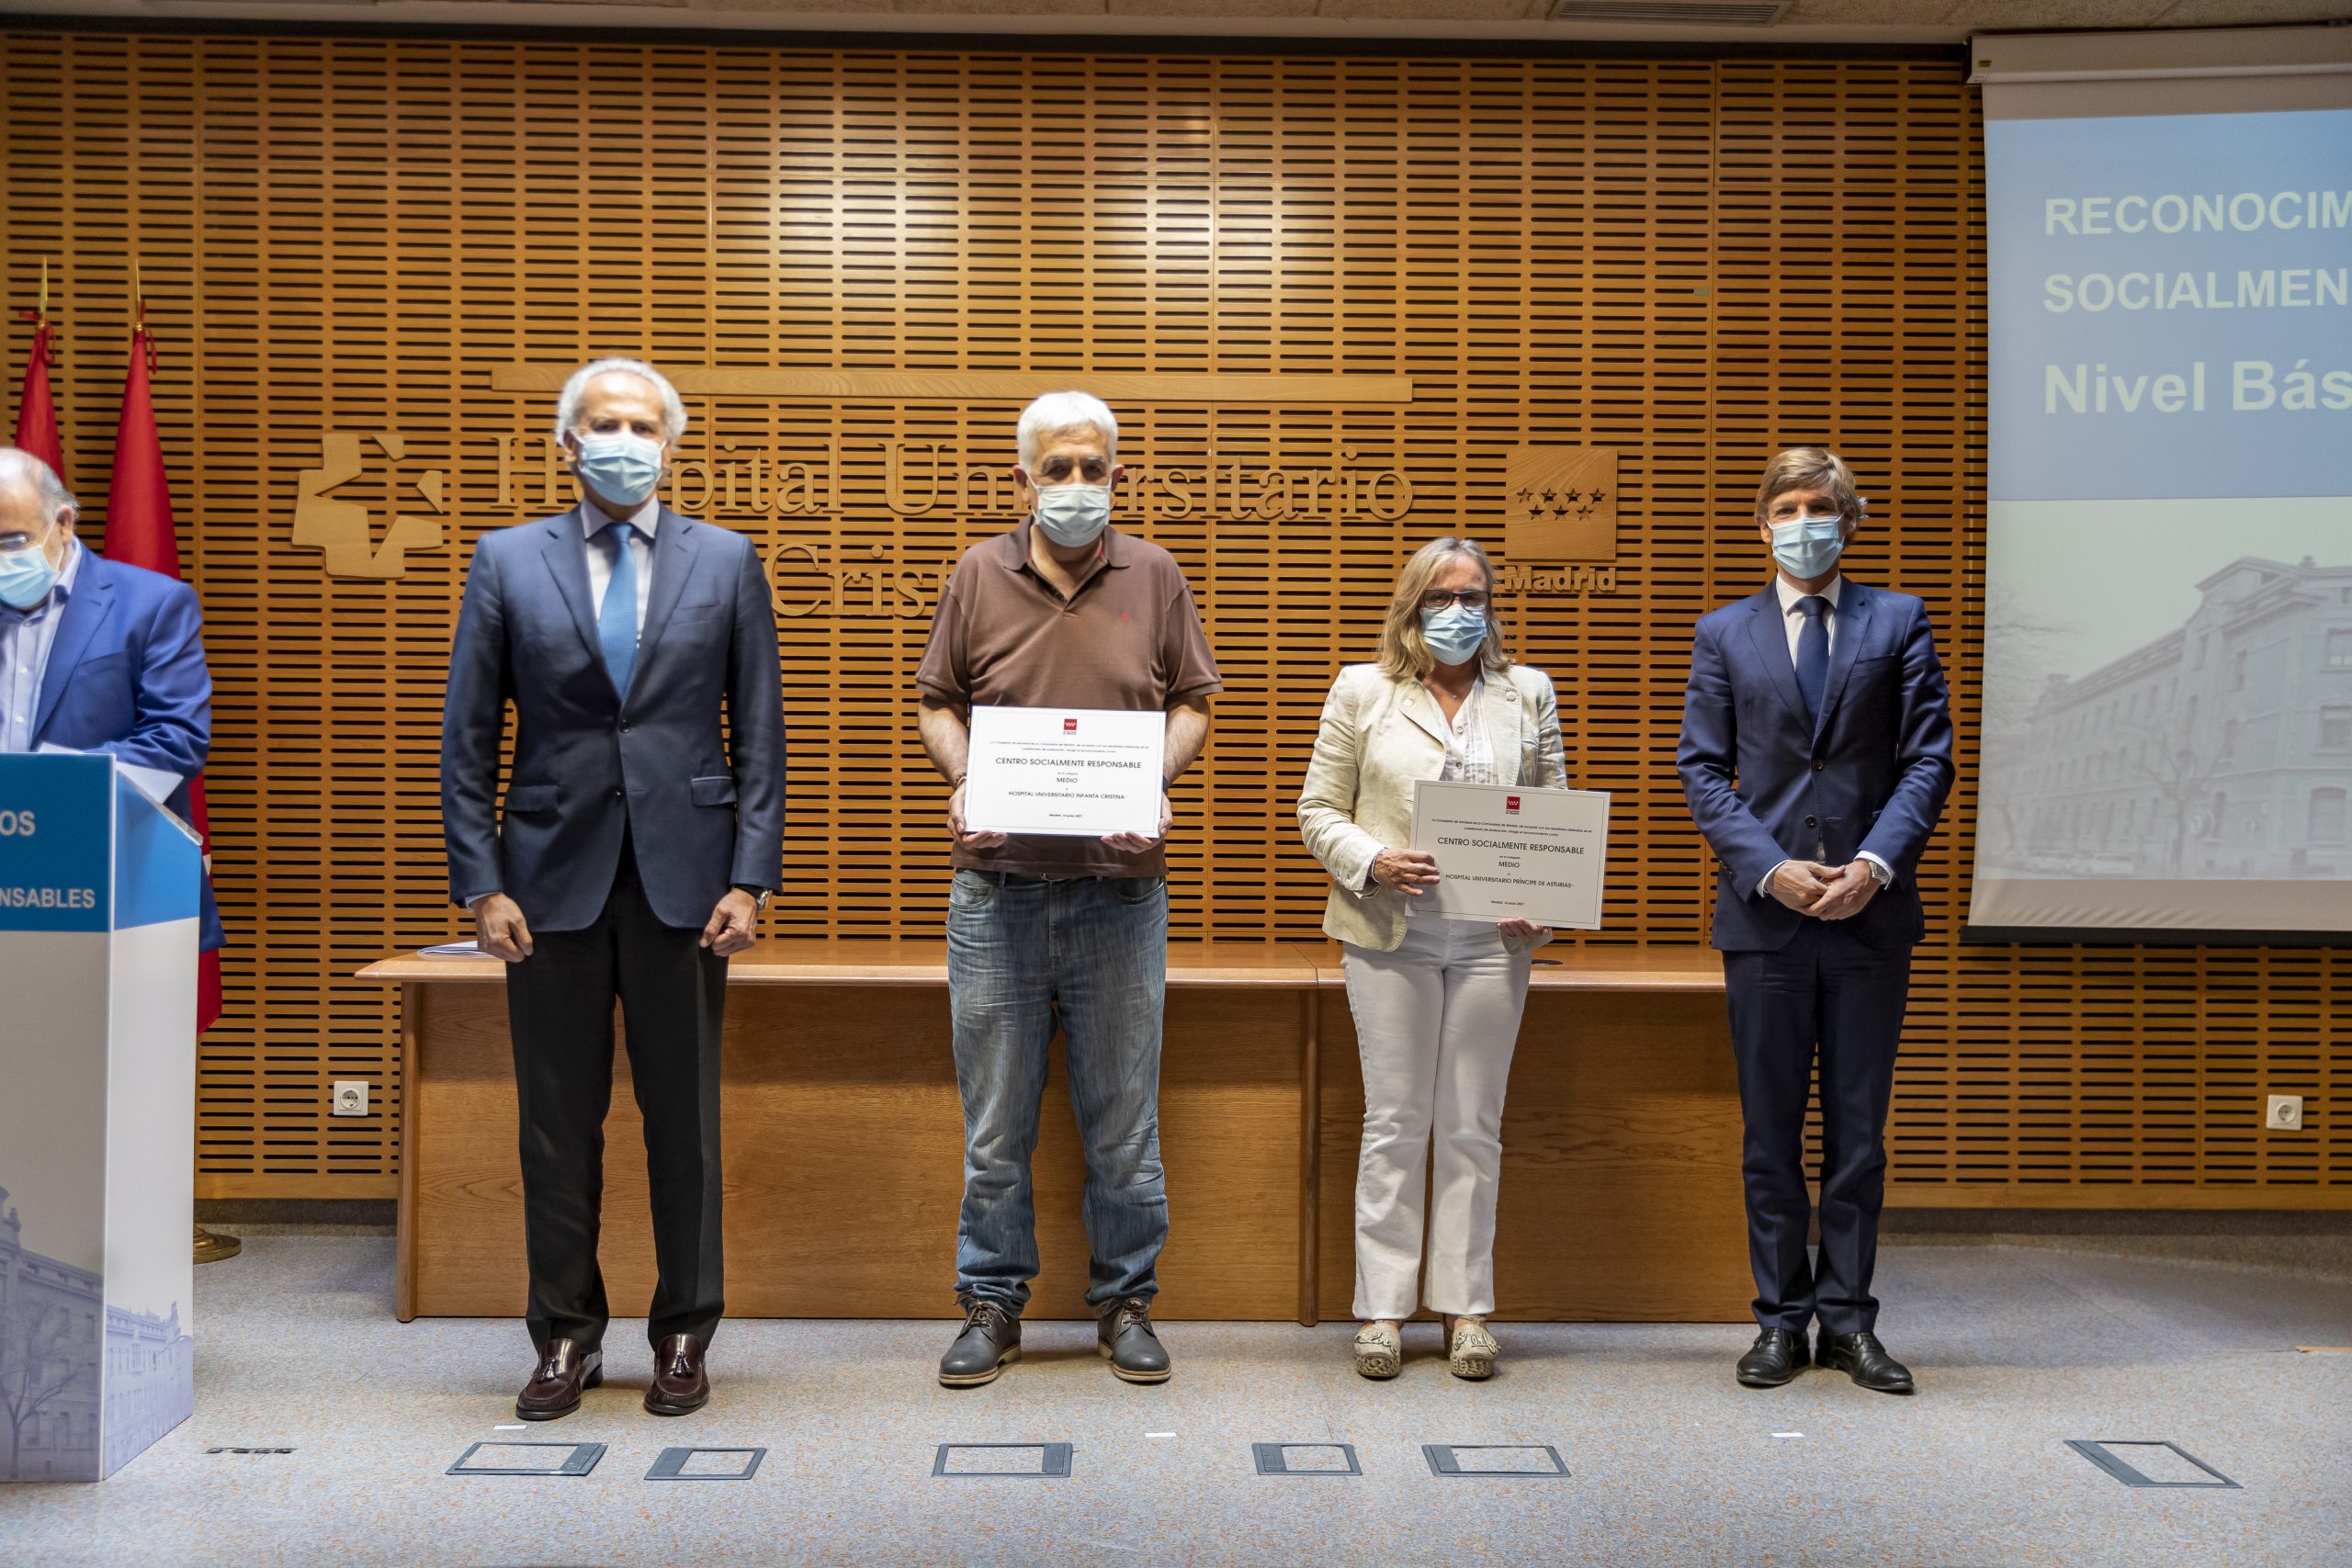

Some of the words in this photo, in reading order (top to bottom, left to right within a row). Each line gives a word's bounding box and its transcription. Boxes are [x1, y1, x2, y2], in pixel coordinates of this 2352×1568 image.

[2045, 191, 2352, 235] RECONOCIM
[2043, 267, 2348, 312] SOCIALMEN
[2045, 362, 2205, 413] Nivel
[2233, 358, 2352, 412] Bás
[491, 436, 843, 515] Hpital
[1505, 566, 1616, 592] Madrid
[995, 757, 1027, 765] CENTRO
[1030, 759, 1085, 767] SOCIALMENTE
[1087, 760, 1141, 769] RESPONSABLE
[0, 810, 36, 836] OS
[1438, 837, 1470, 846] CENTRO
[1472, 839, 1527, 851] SOCIALMENTE
[1530, 843, 1584, 854] RESPONSABLE
[1472, 875, 1512, 884] UNIVERSITARIO
[0, 886, 96, 908] NSABLES
